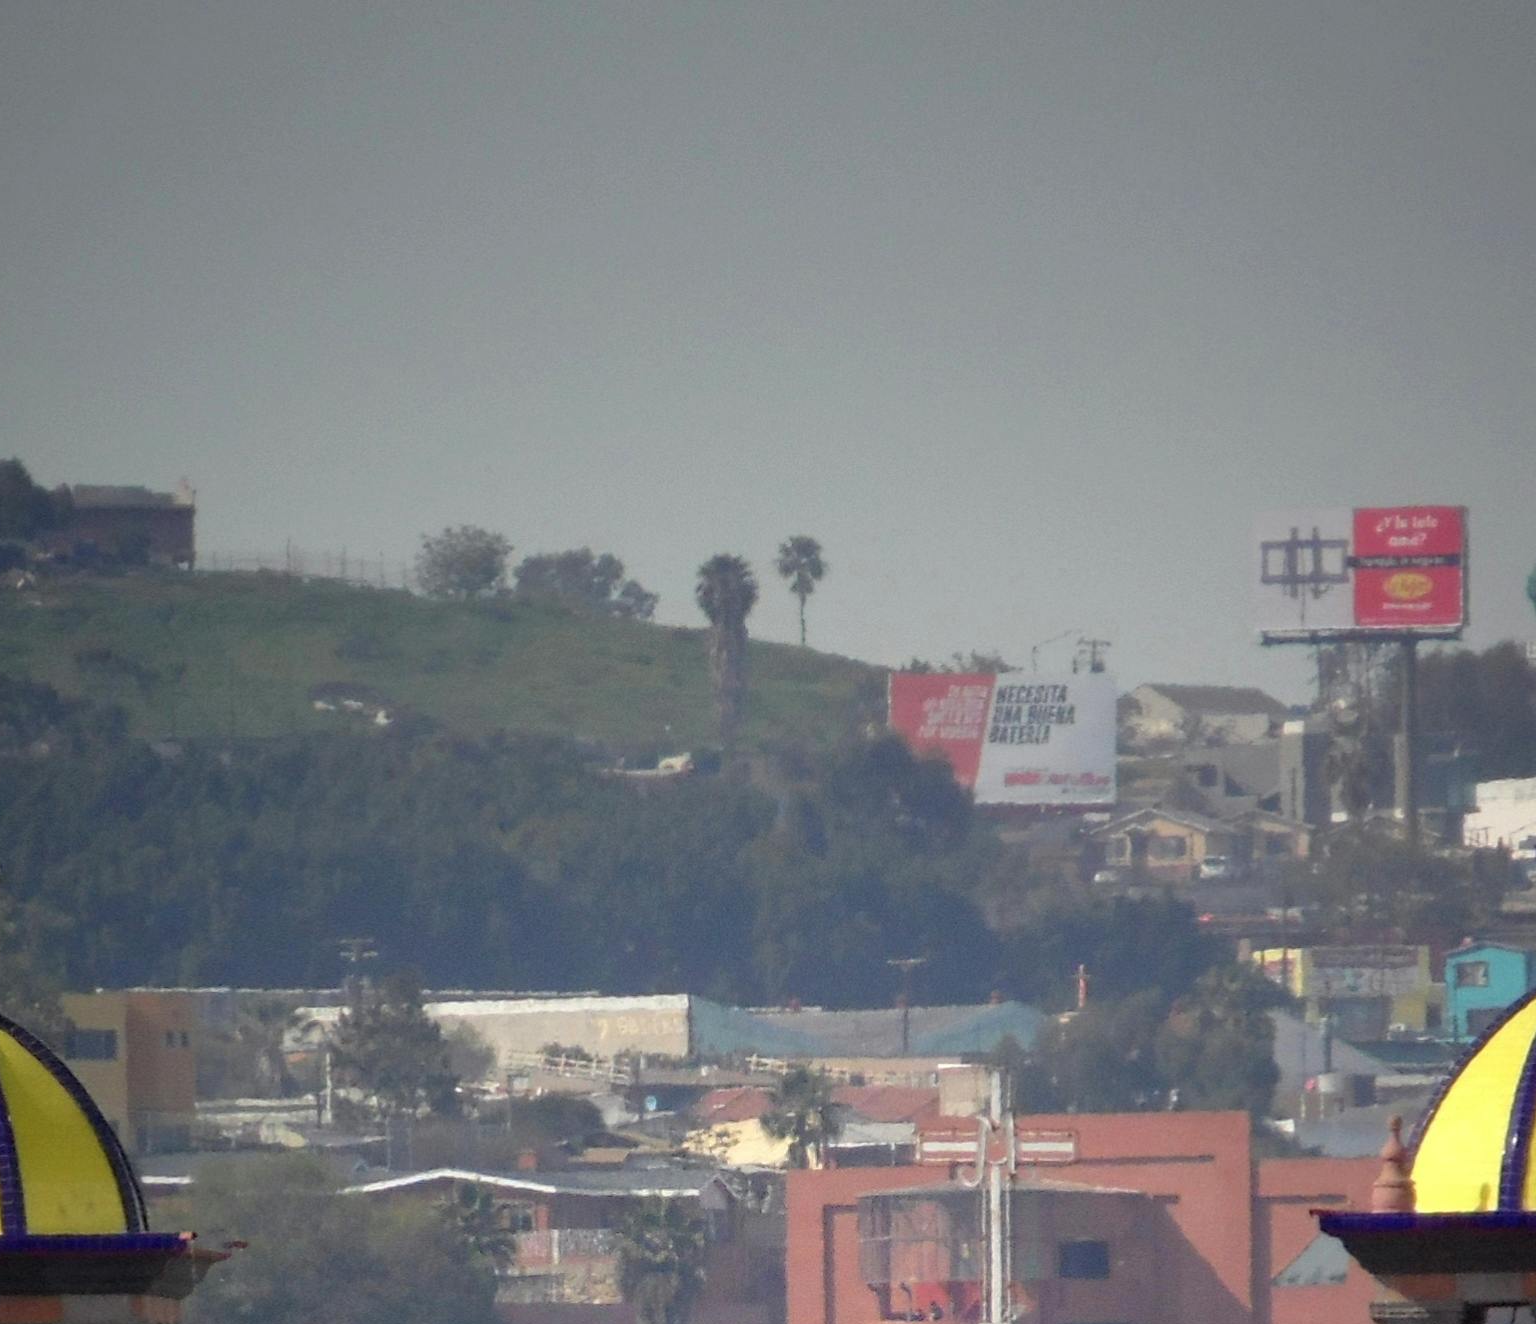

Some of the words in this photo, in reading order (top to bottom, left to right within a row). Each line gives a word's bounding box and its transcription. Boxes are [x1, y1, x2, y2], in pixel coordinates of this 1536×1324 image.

[996, 684, 1068, 704] NECESITA
[993, 705, 1023, 724] UNA
[1028, 705, 1075, 725] BUENA
